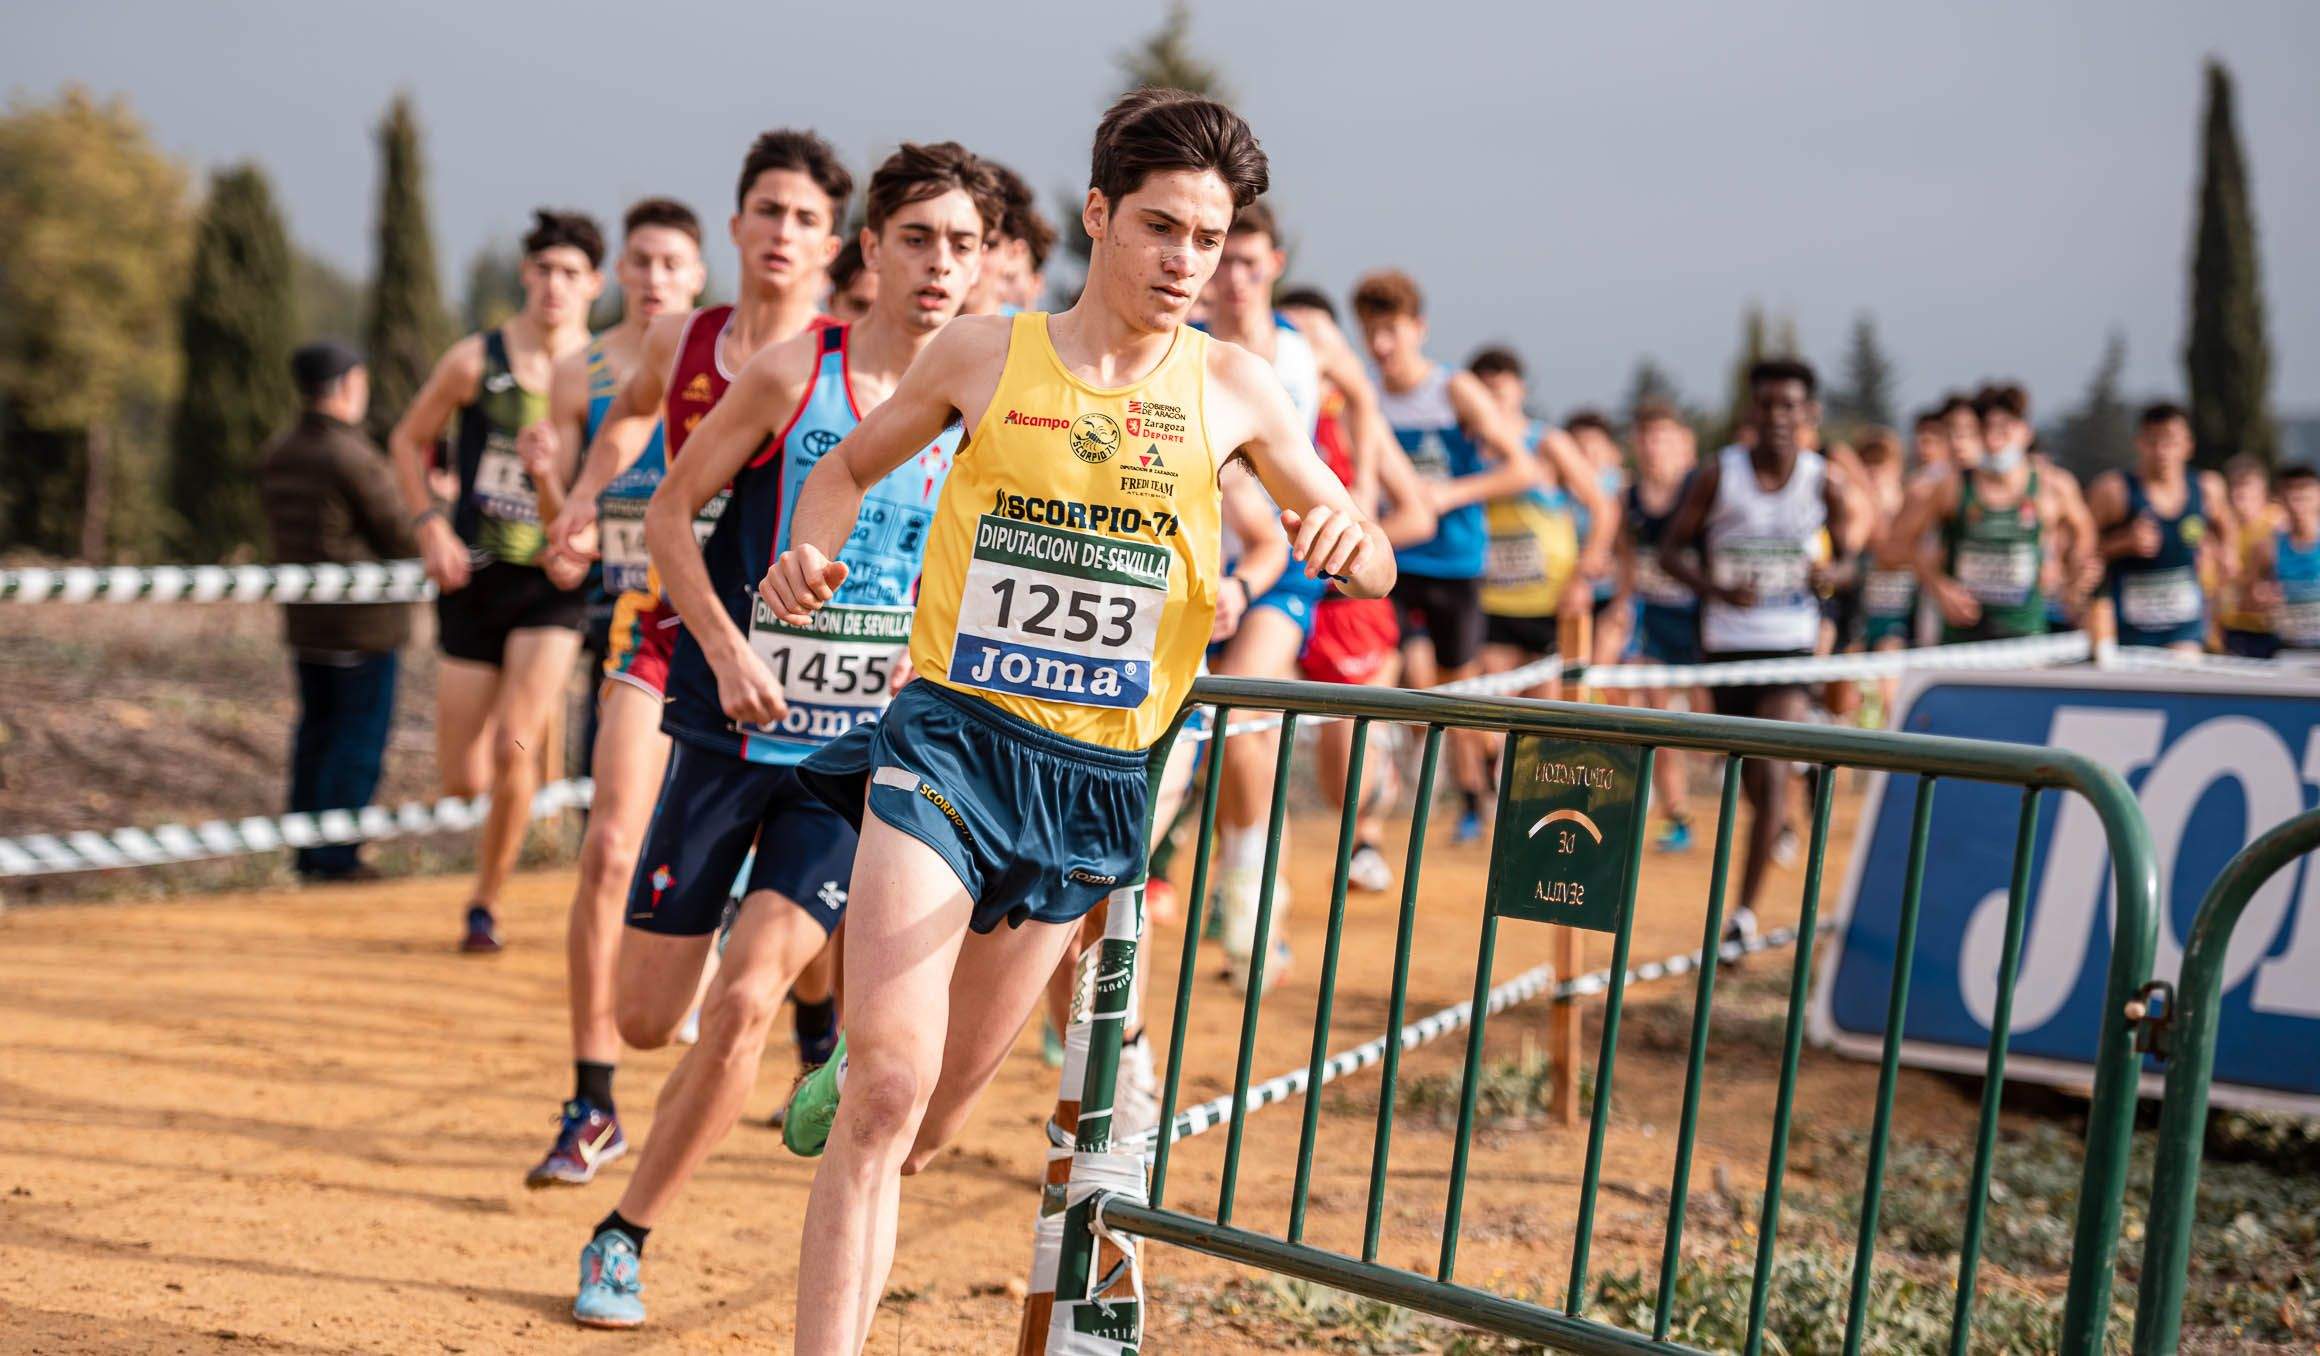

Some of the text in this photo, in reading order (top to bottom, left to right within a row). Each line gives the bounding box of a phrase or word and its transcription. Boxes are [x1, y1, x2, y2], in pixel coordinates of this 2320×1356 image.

[1004, 410, 1070, 430] Alcampo
[1141, 408, 1152, 416] DE
[1144, 418, 1185, 432] Zaragoza
[1073, 440, 1116, 462] SCORPIO 71
[1120, 476, 1174, 497] FREDI TEAM
[1007, 494, 1179, 537] SCORPIO-71
[979, 523, 1168, 580] DIPUTACION DE SEVILLA
[991, 577, 1137, 648] 1253
[843, 613, 863, 635] DE
[771, 645, 889, 695] 1455
